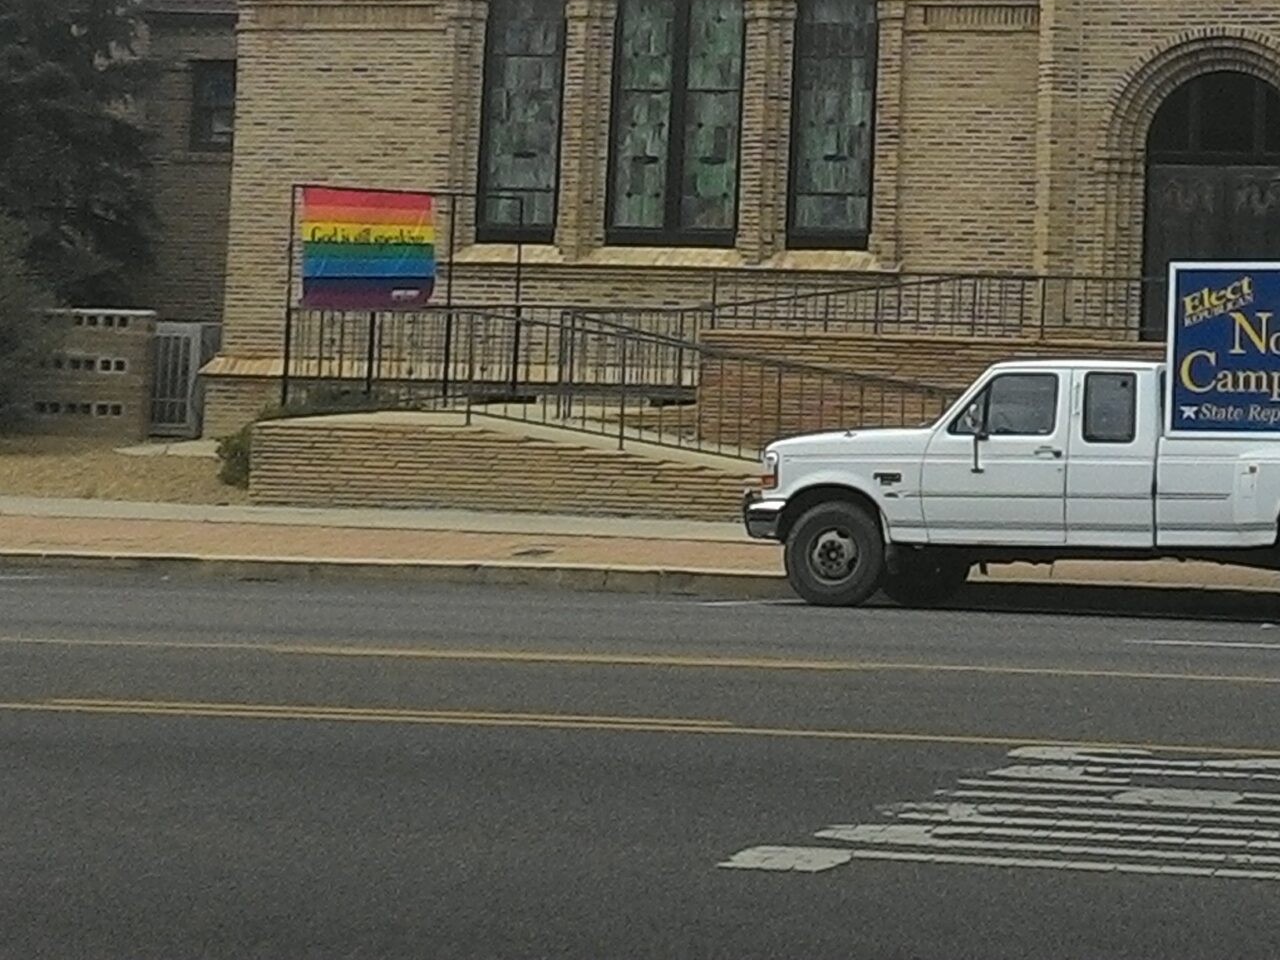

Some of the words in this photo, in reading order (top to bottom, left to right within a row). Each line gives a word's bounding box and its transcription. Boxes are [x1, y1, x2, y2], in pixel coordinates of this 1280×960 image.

[311, 226, 338, 243] God
[1183, 276, 1252, 317] Elect
[1184, 294, 1254, 327] REPUBLICAN
[1200, 403, 1244, 421] State
